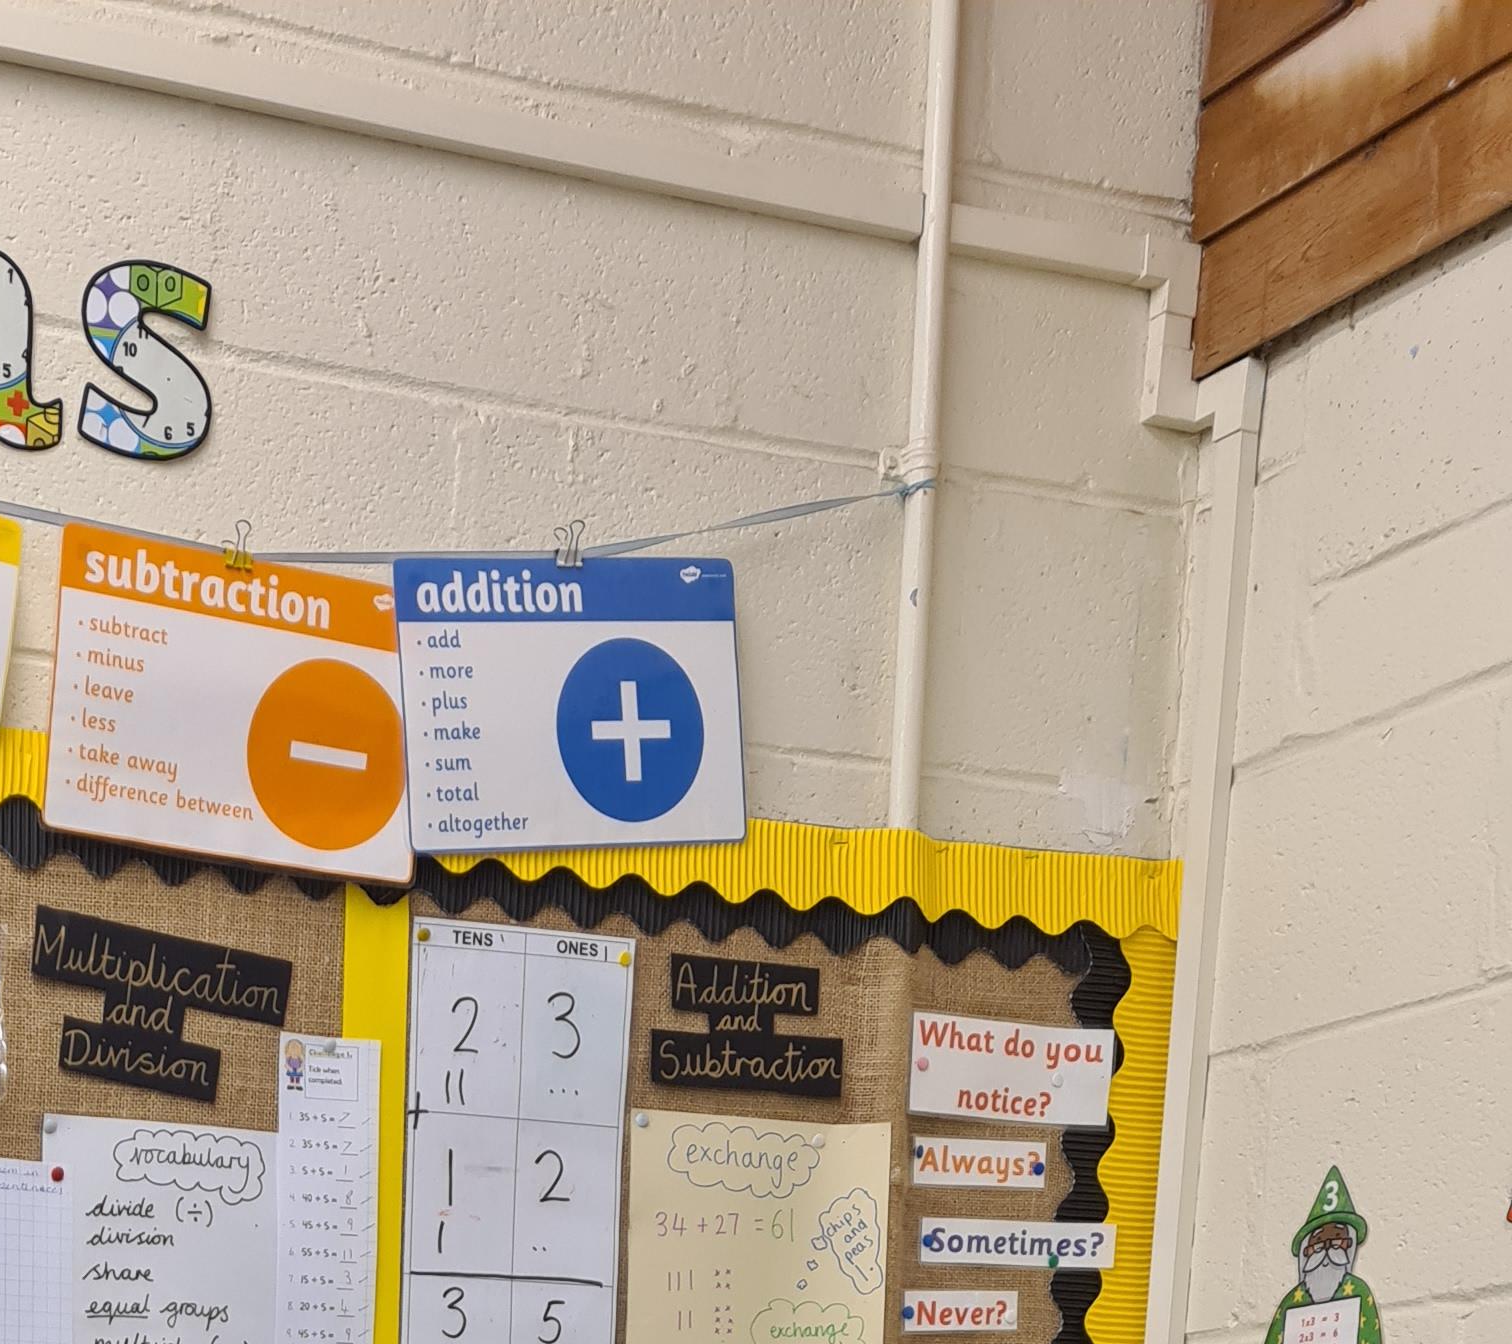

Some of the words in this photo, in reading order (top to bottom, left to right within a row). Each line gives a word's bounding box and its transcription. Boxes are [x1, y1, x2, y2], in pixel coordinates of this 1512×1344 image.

[85, 547, 332, 630] subtraction
[416, 569, 584, 614] addition
[89, 614, 169, 646] subtract
[88, 648, 145, 672] minus
[430, 664, 474, 681] more
[434, 722, 481, 741] make
[79, 742, 122, 766] take
[128, 754, 178, 781] away
[76, 772, 169, 811] difference
[176, 789, 254, 820] between
[436, 783, 479, 802] total
[438, 813, 529, 839] altogether
[453, 931, 493, 947] TENS
[557, 940, 599, 957] ONES
[35, 924, 281, 1014] Multiplication
[676, 966, 810, 1013] Addition
[105, 995, 174, 1034] and
[716, 1008, 762, 1033] and
[64, 1029, 209, 1086] Division
[659, 1039, 840, 1080] Subtraction
[919, 1019, 995, 1053] What
[1004, 1028, 1035, 1058] do
[1046, 1042, 1103, 1069] you
[958, 1087, 1051, 1117] notice?
[130, 1144, 251, 1194] vocabulary
[686, 1140, 800, 1187] exchange
[919, 1145, 1040, 1183] Always?
[85, 1198, 155, 1220] divide
[86, 1228, 174, 1248] division
[930, 1227, 1104, 1257] Sometimes?
[82, 1264, 154, 1283] share
[86, 1298, 149, 1324] equal
[160, 1303, 229, 1325] groups
[917, 1300, 1006, 1326] Never?
